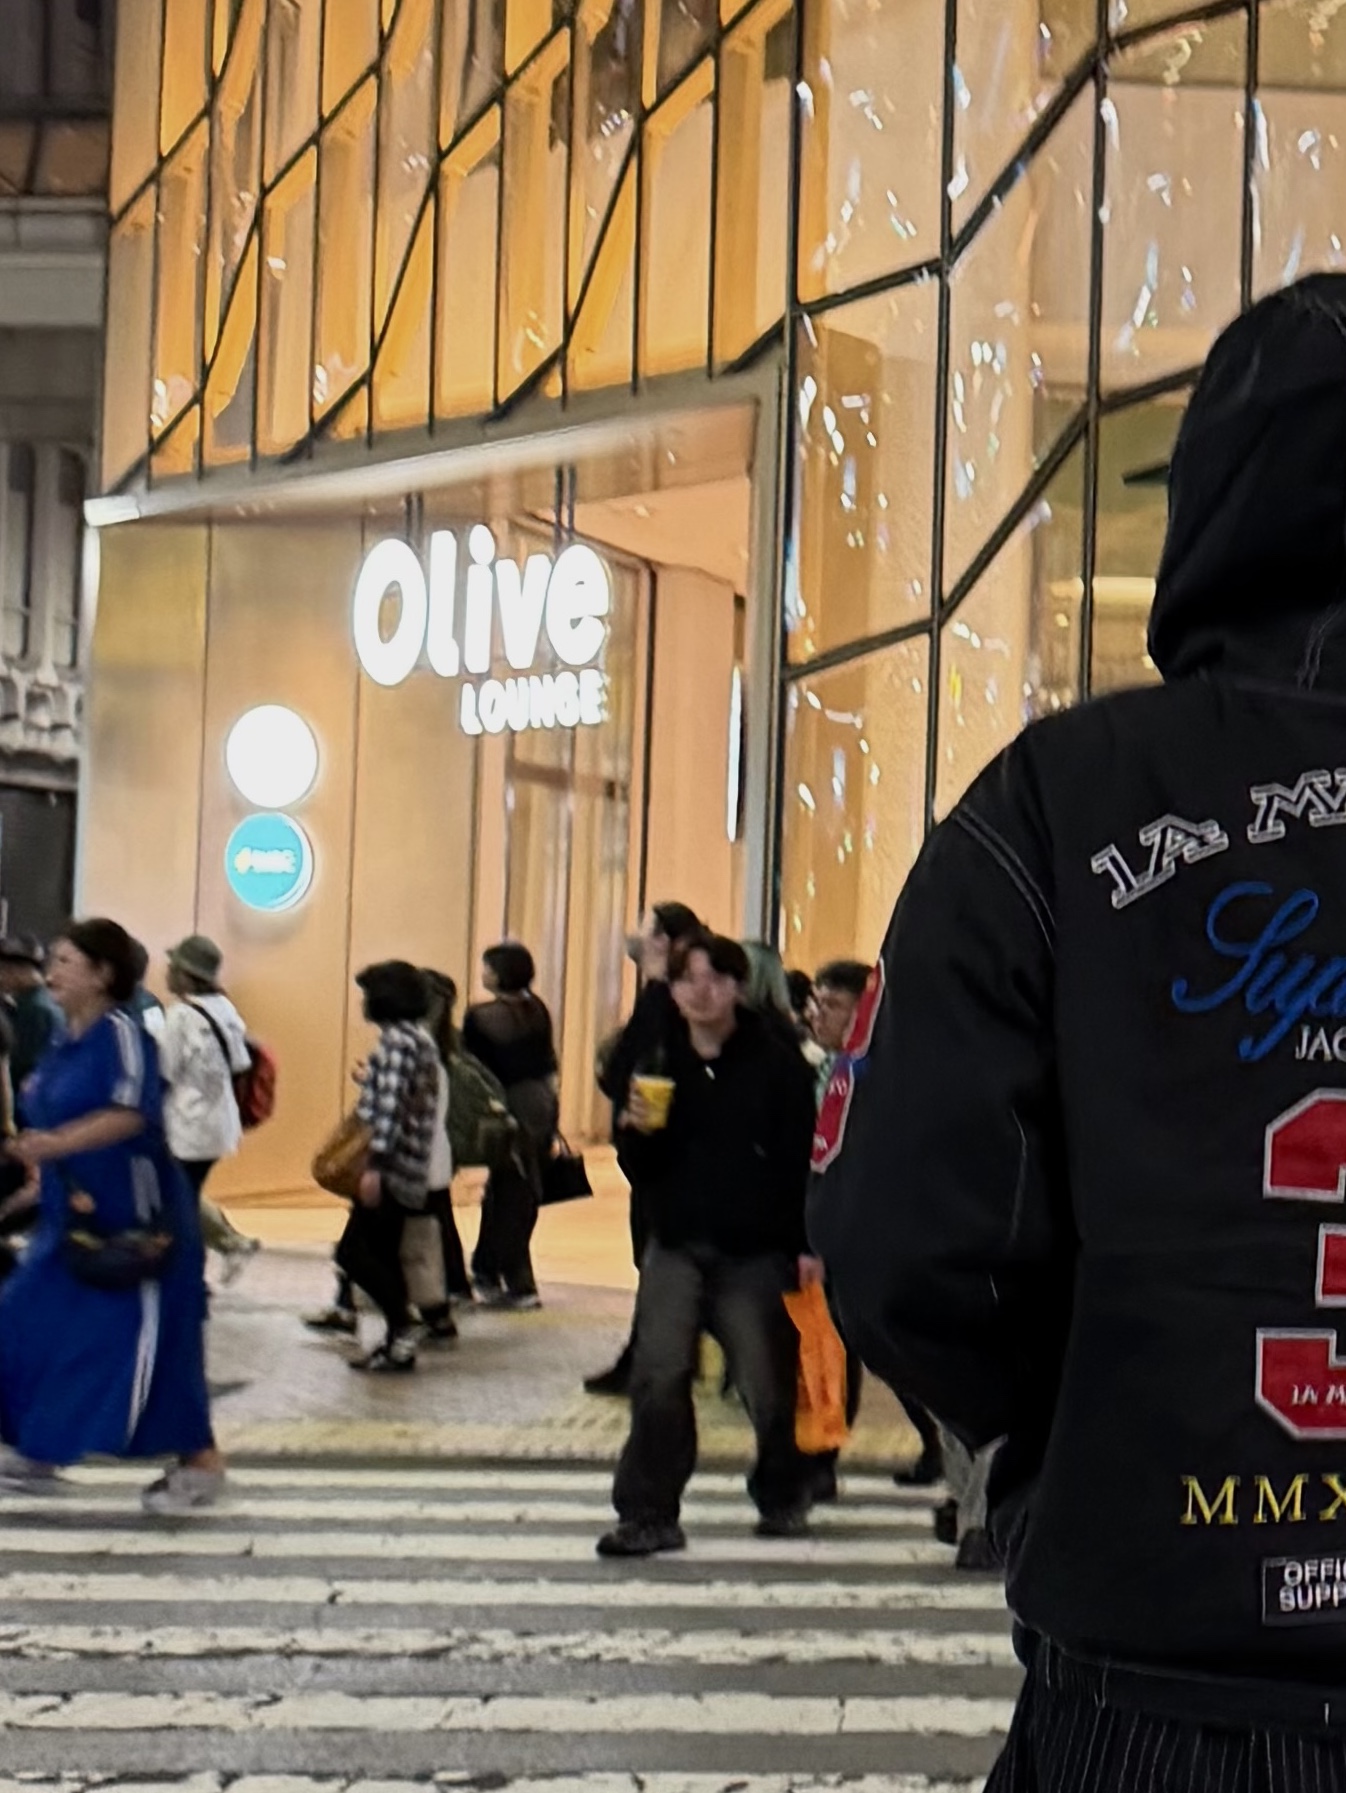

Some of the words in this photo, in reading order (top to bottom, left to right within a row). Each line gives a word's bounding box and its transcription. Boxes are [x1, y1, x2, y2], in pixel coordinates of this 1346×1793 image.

[354, 524, 610, 686] Olive
[460, 668, 607, 735] LOUNGE
[1091, 813, 1229, 909] LA
[1291, 1383, 1318, 1406] LA
